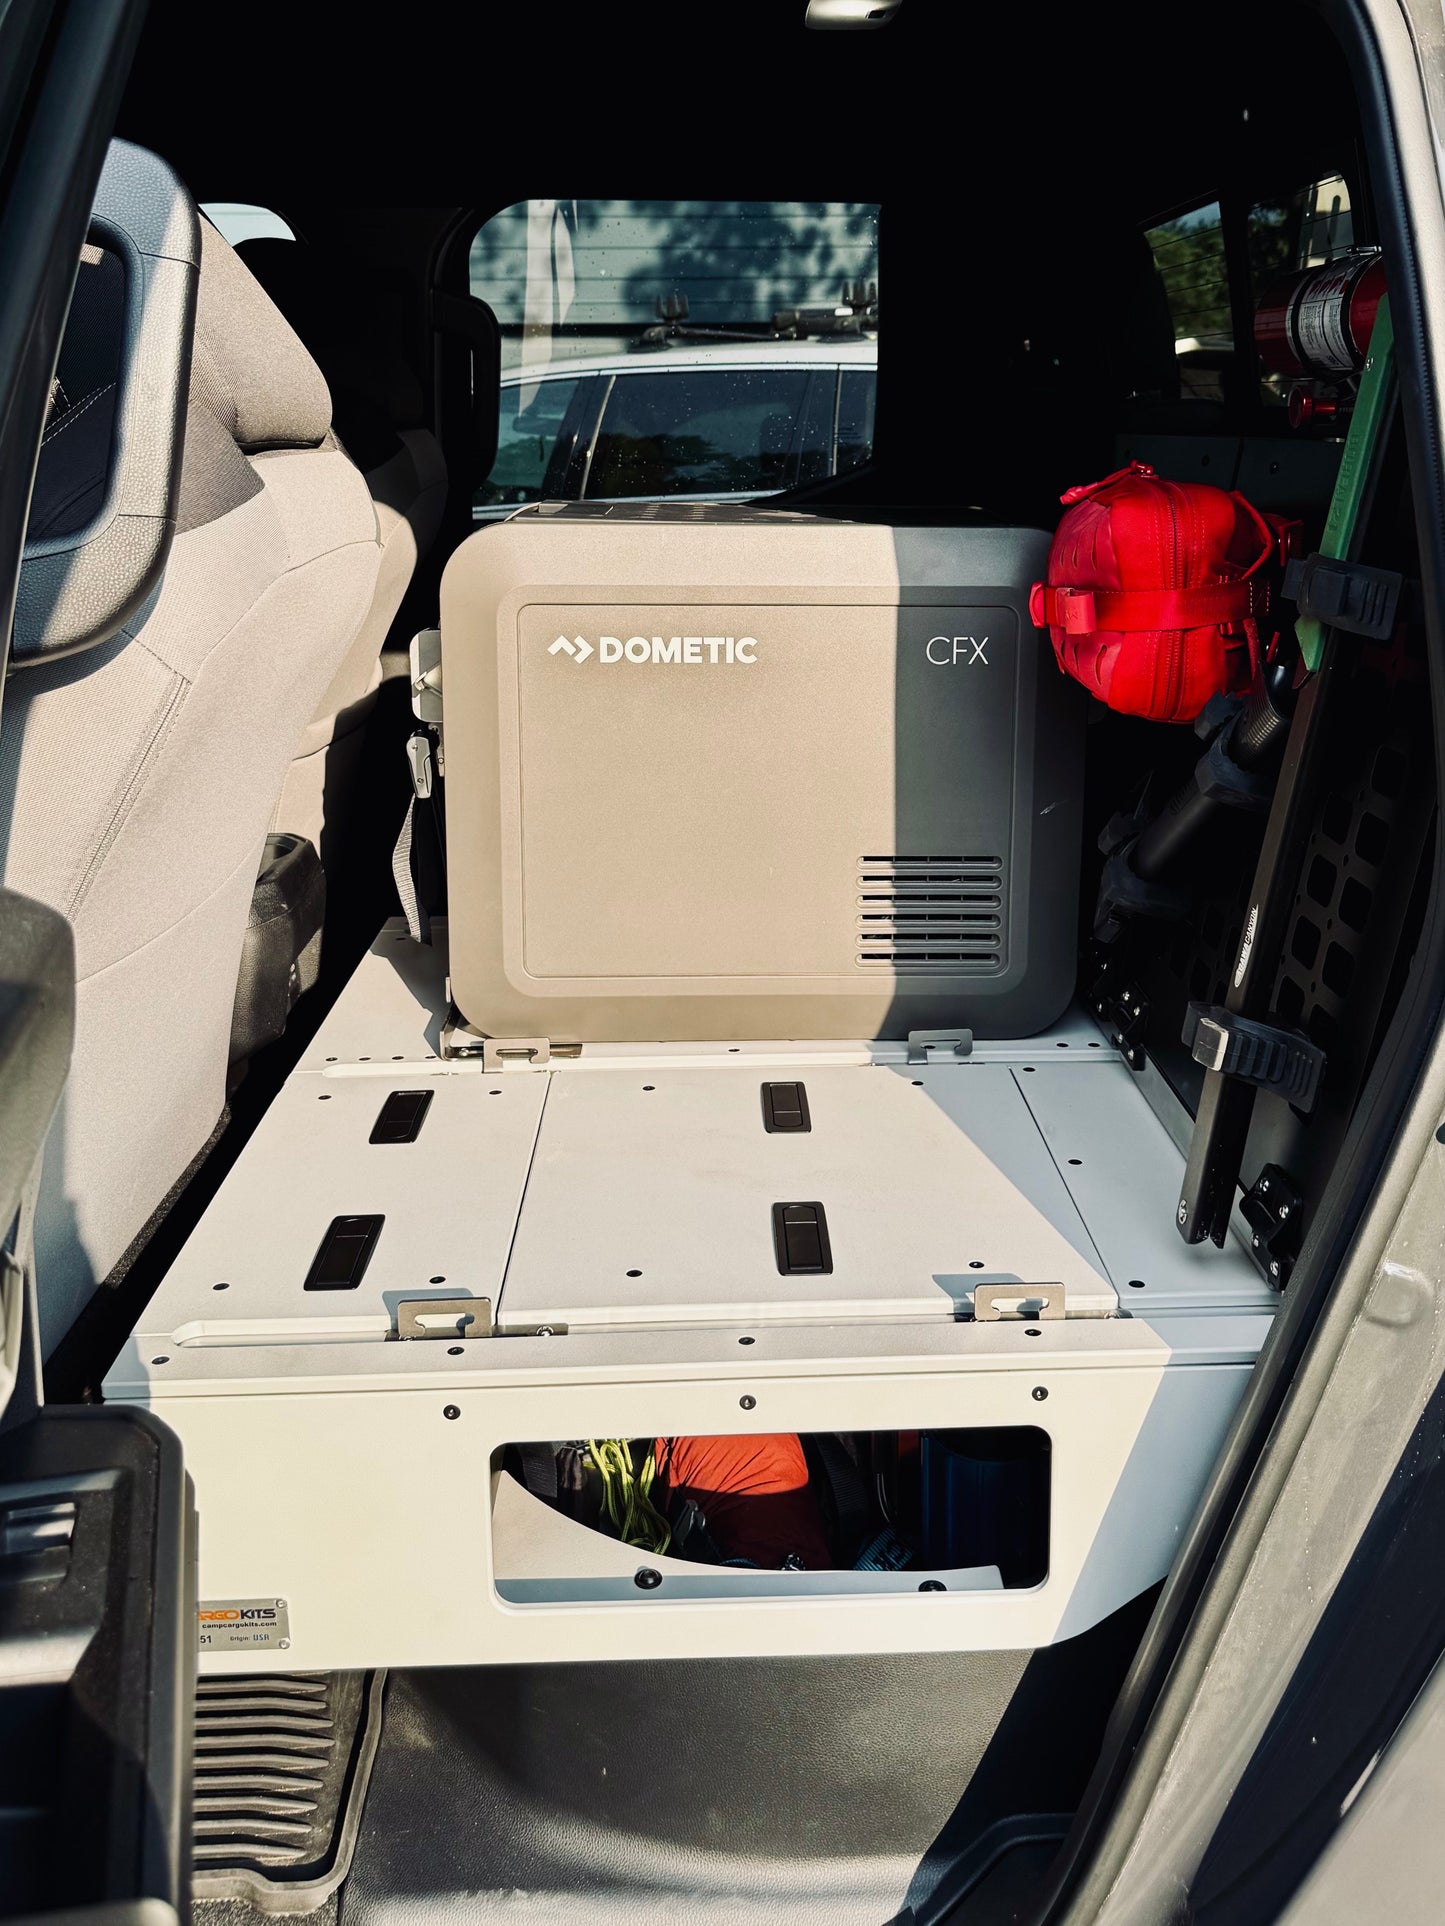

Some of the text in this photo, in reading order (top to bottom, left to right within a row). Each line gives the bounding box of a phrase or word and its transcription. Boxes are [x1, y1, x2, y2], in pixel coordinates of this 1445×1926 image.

[600, 636, 758, 664] DOMETIC
[926, 636, 989, 665] CFX
[198, 1608, 276, 1621] RGOKITS
[202, 1621, 277, 1629] campcargokits.com
[253, 1633, 270, 1641] USA
